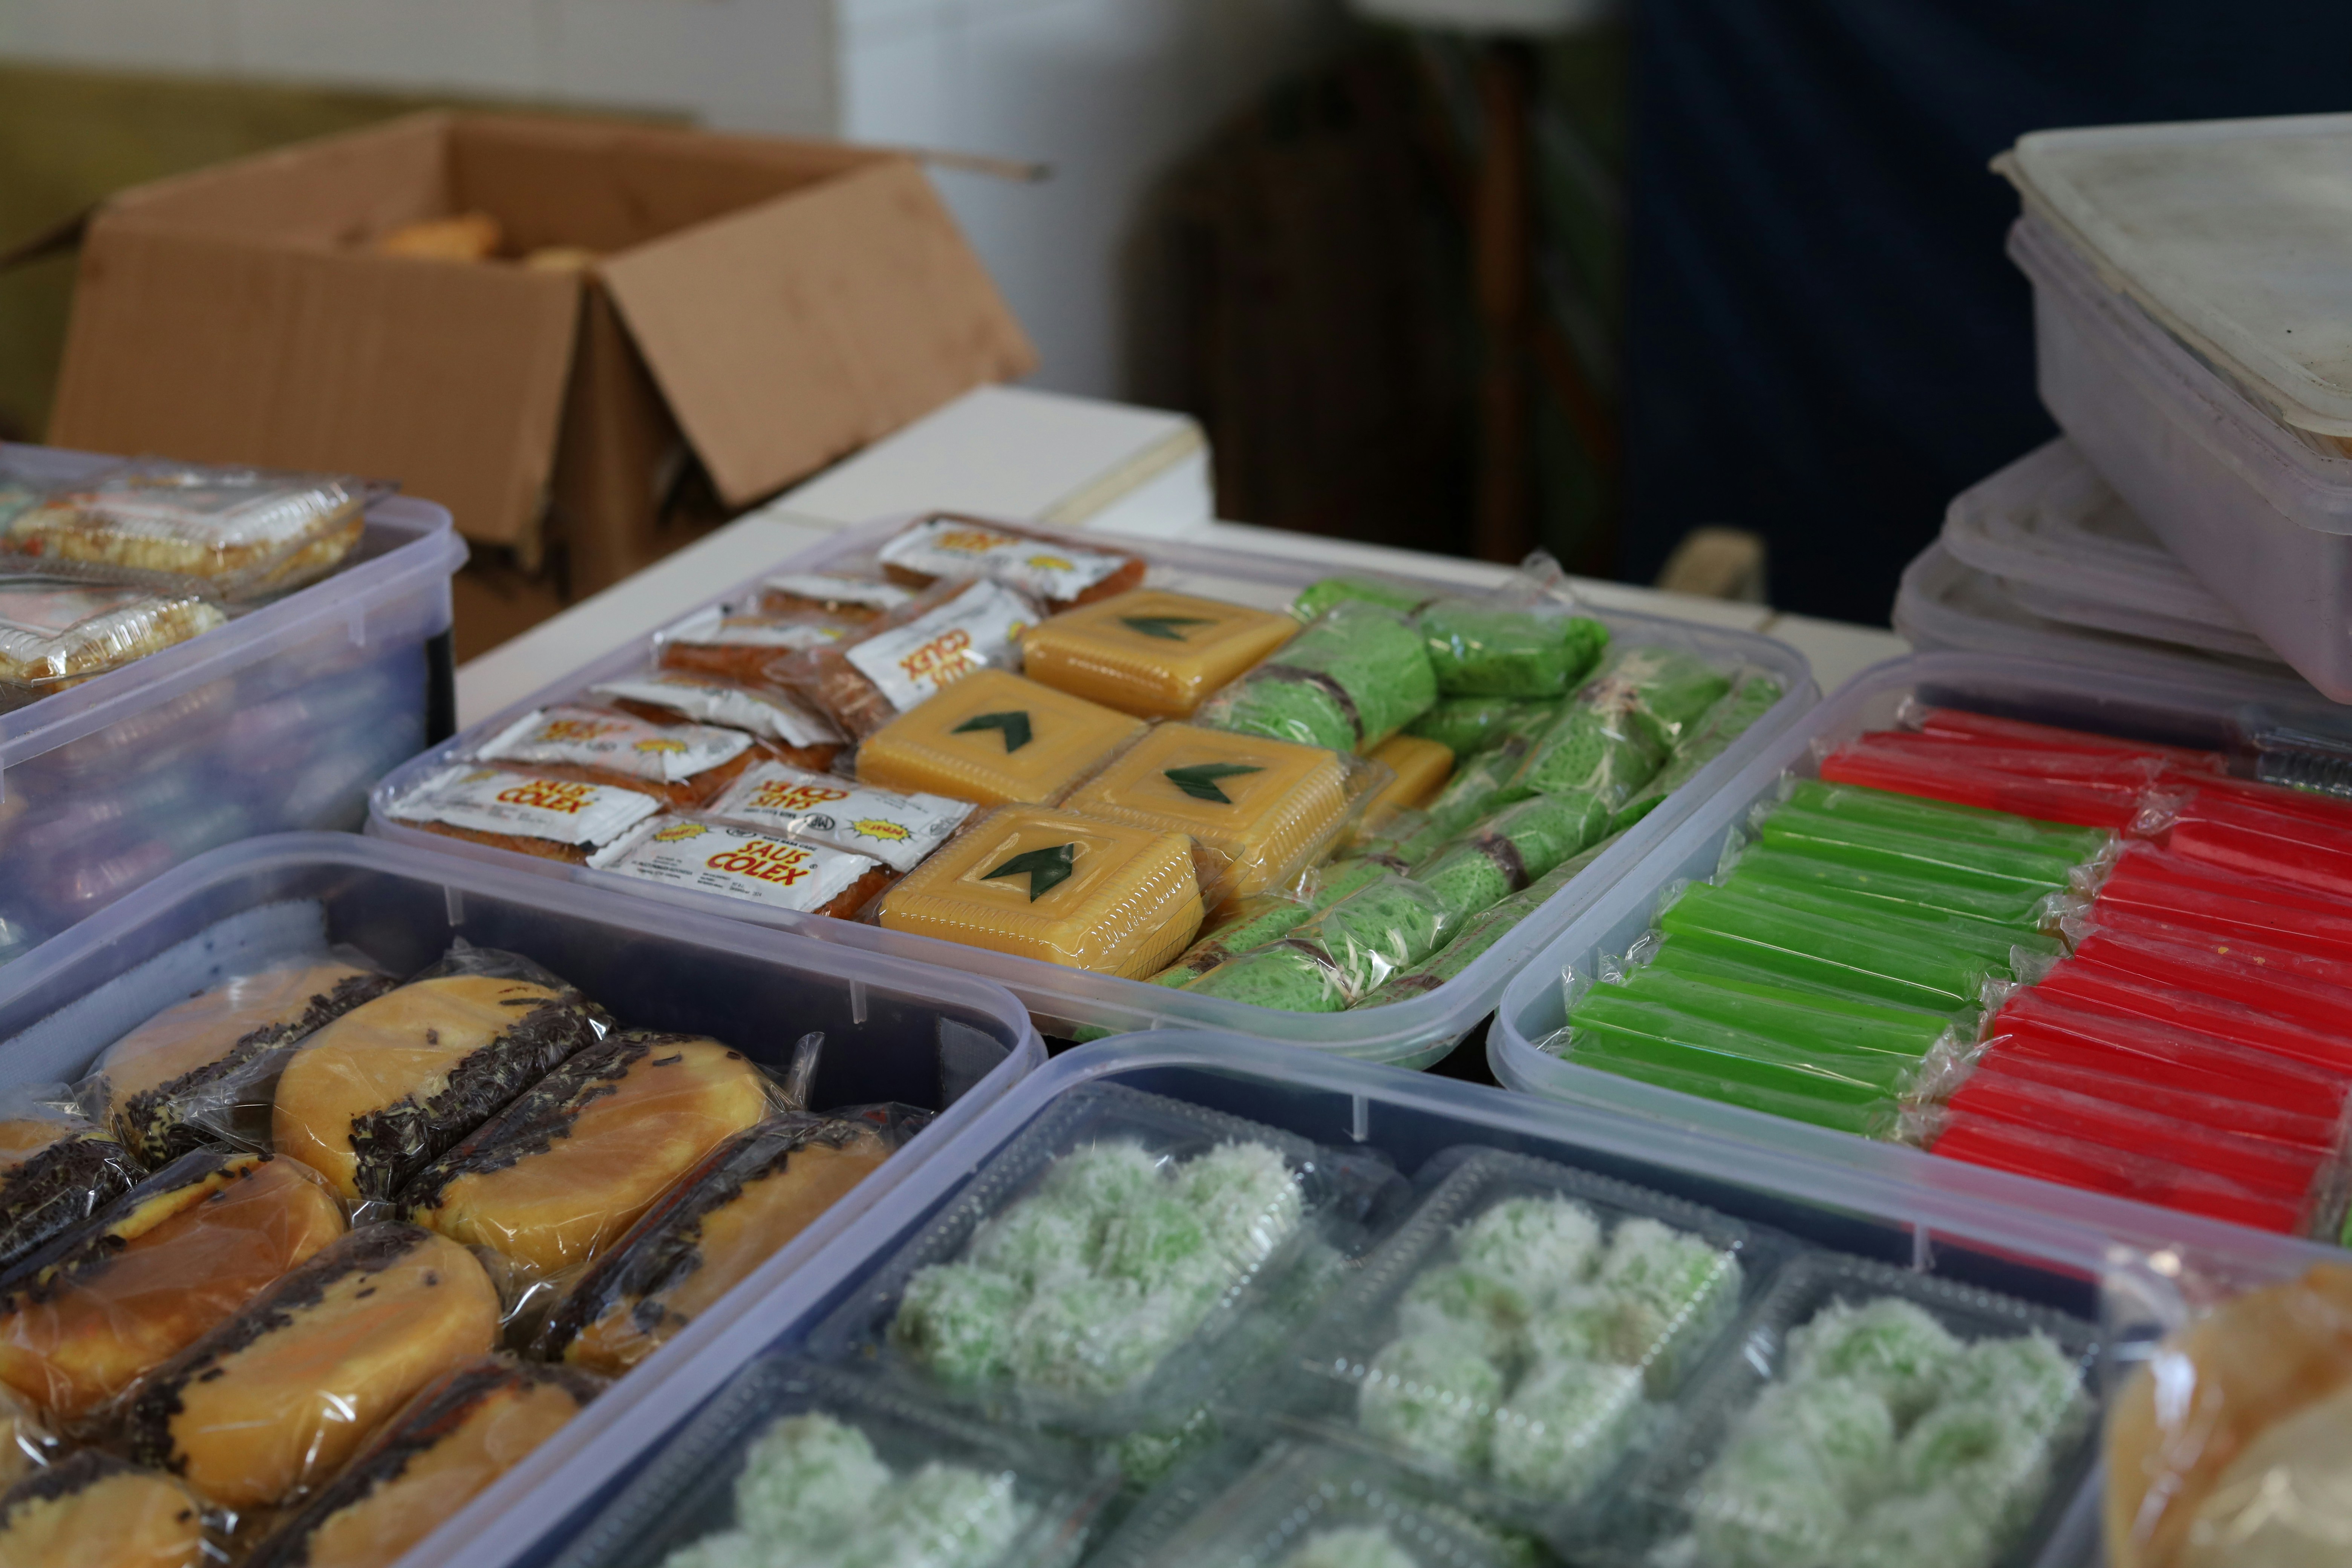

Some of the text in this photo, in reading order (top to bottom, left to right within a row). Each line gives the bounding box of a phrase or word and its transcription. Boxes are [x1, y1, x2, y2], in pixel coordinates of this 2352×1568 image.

[497, 787, 593, 813] COLEX
[737, 840, 811, 864] SAUS
[706, 852, 809, 886] COLEX
